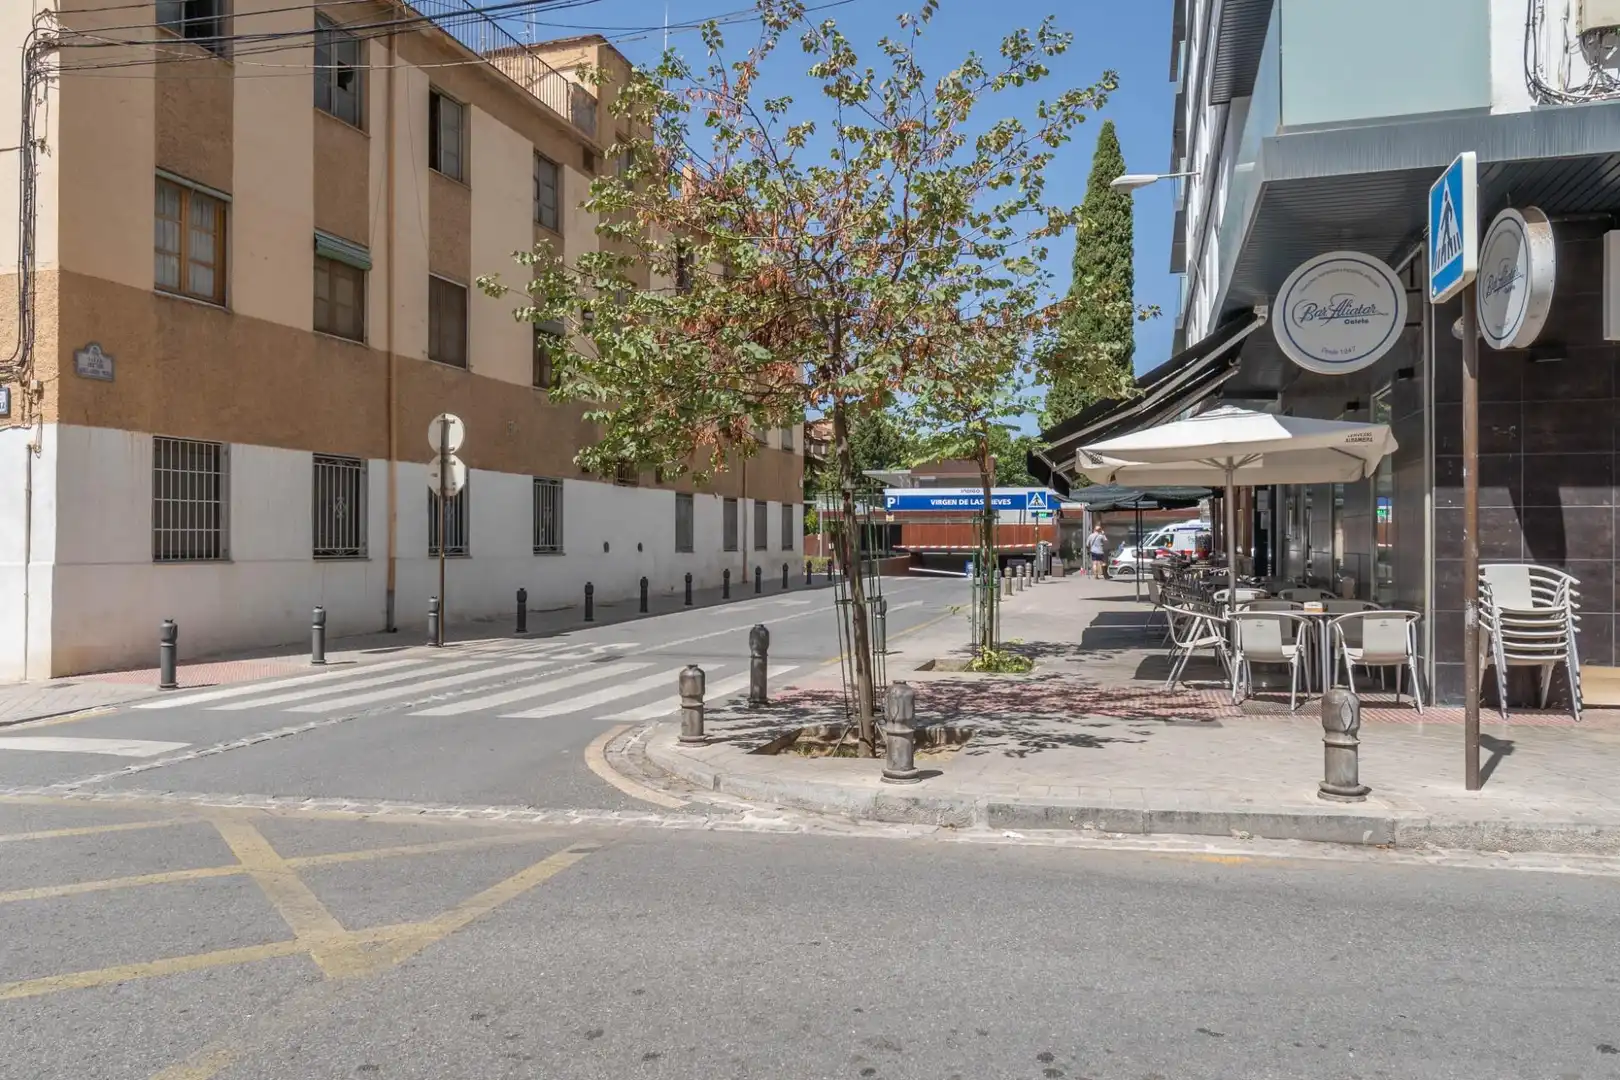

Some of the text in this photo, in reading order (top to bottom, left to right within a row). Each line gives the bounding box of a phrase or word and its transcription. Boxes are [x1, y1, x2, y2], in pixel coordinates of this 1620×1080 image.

[1293, 294, 1384, 326] Bar Aliatar
[887, 497, 896, 508] P
